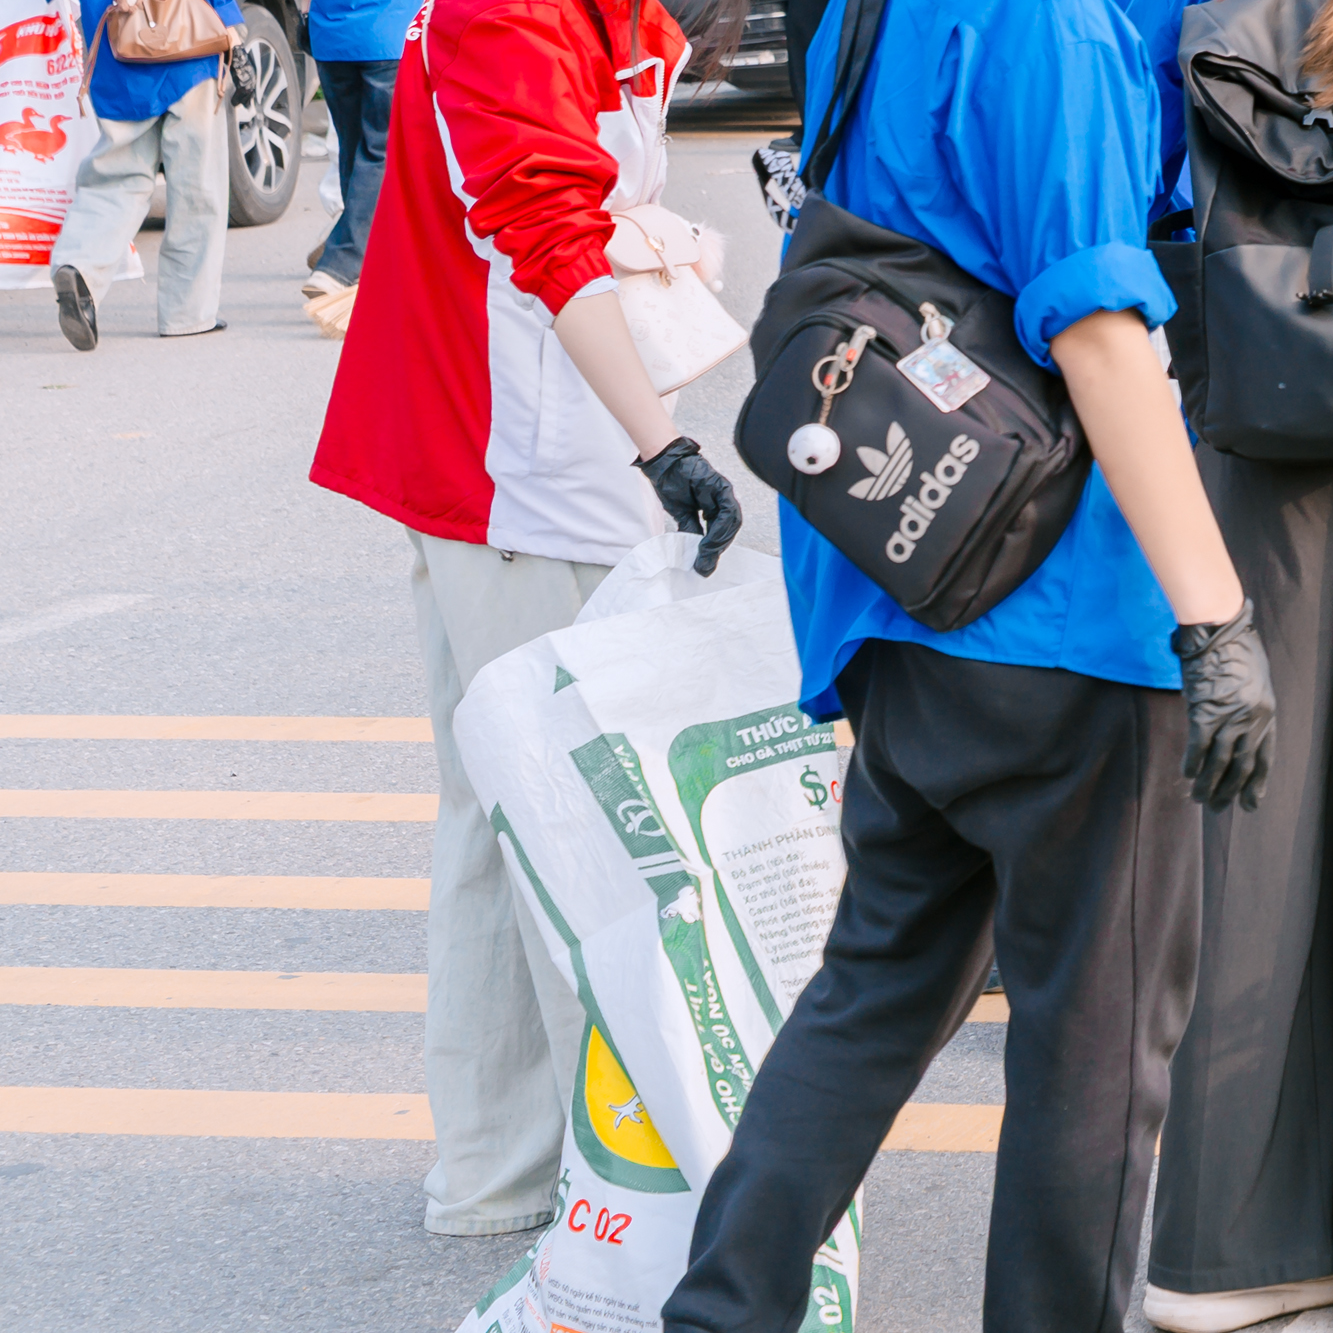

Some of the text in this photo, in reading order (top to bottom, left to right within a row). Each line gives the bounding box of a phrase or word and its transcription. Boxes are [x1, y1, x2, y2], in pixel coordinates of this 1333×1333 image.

[886, 434, 981, 563] adidas
[736, 713, 799, 747] THỨC
[726, 751, 755, 768] CHO
[755, 746, 777, 760] GÀ
[775, 738, 804, 754] THỊT
[722, 838, 774, 863] THÀNH
[775, 826, 815, 846] PHẦN
[770, 947, 823, 966] Methionin
[567, 1199, 591, 1233] C
[594, 1207, 633, 1246] 02
[813, 1284, 843, 1325] 02
